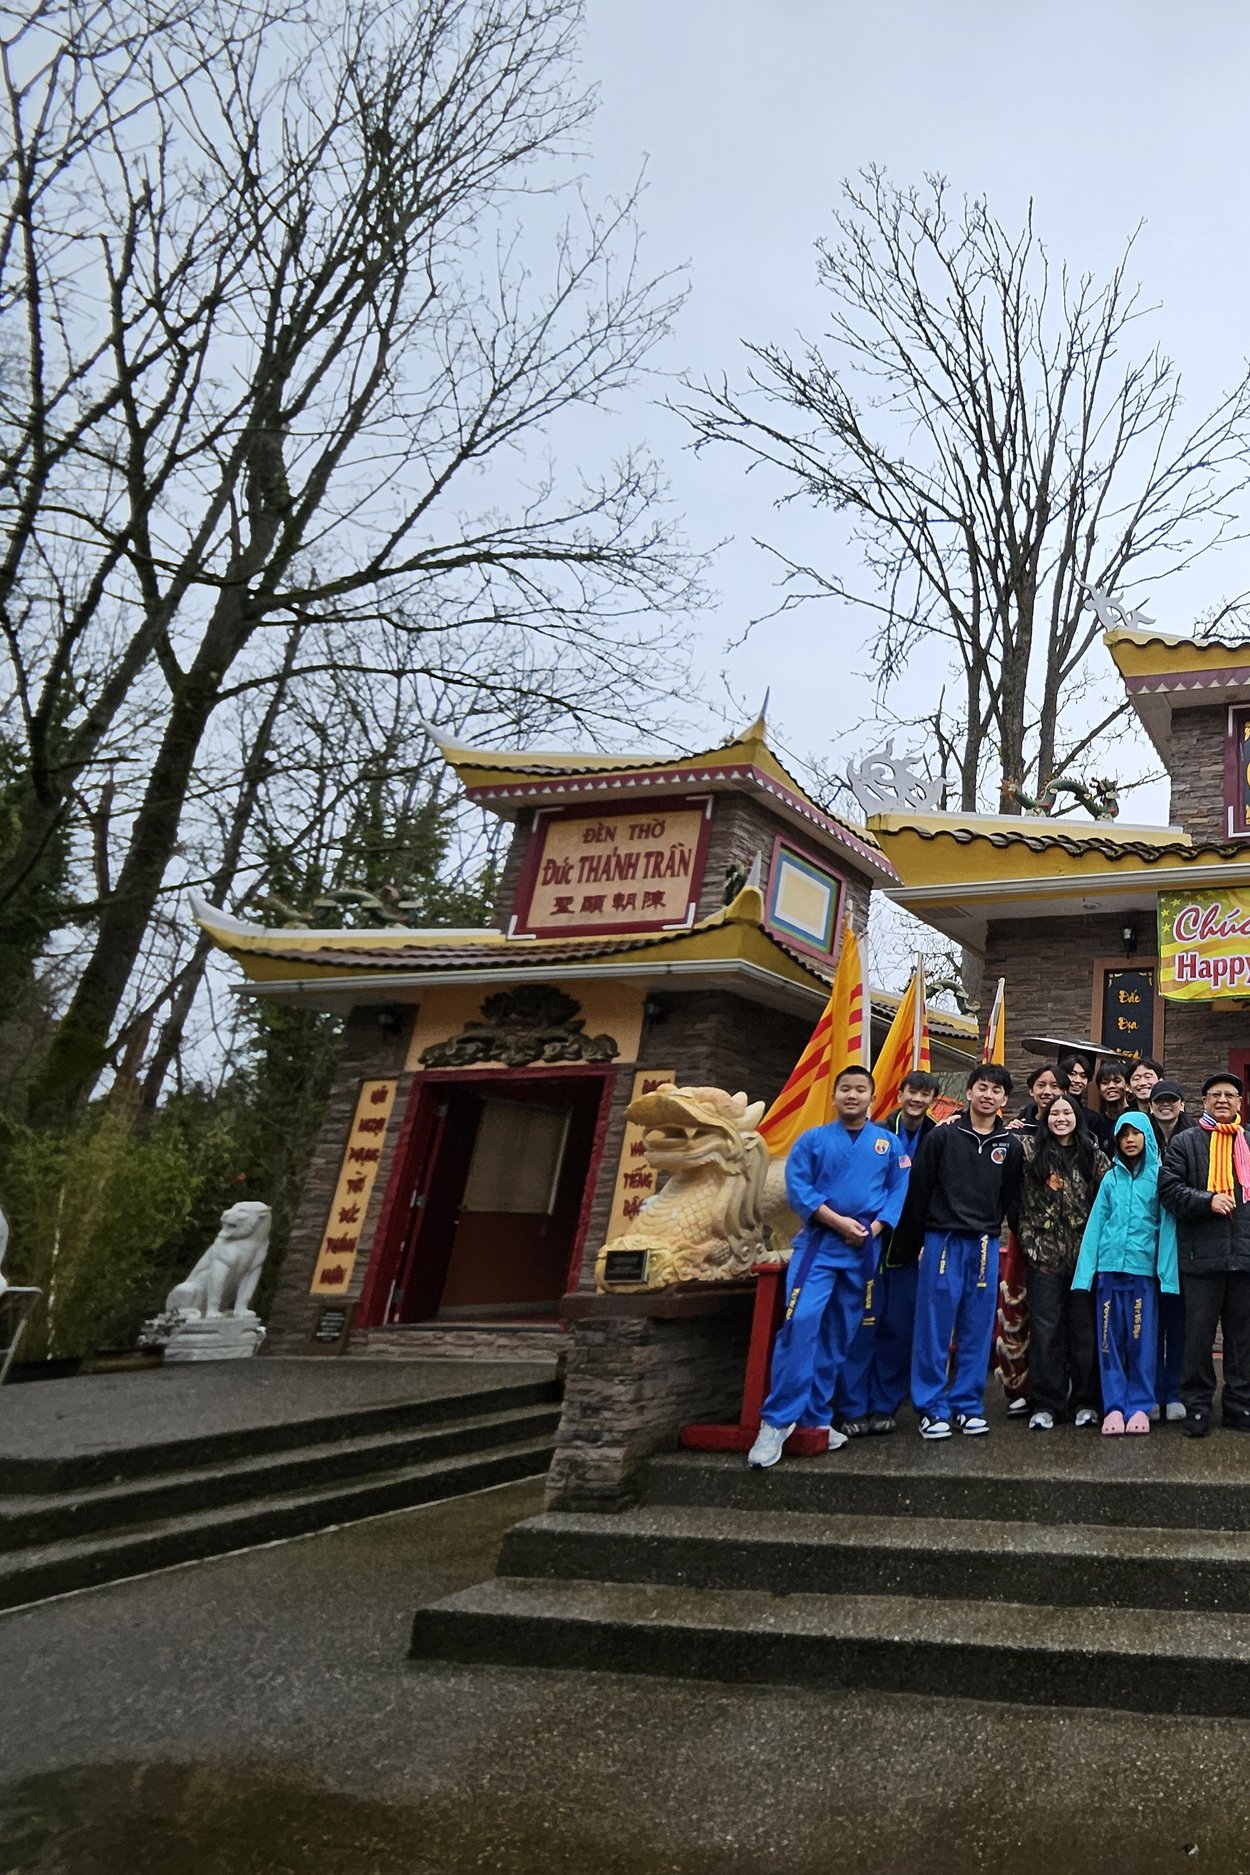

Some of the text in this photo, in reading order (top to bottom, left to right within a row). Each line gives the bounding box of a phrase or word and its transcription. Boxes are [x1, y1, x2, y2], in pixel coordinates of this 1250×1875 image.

[628, 818, 667, 841] THỜ
[577, 846, 642, 884] THÁNH
[644, 842, 693, 879] TRẦN
